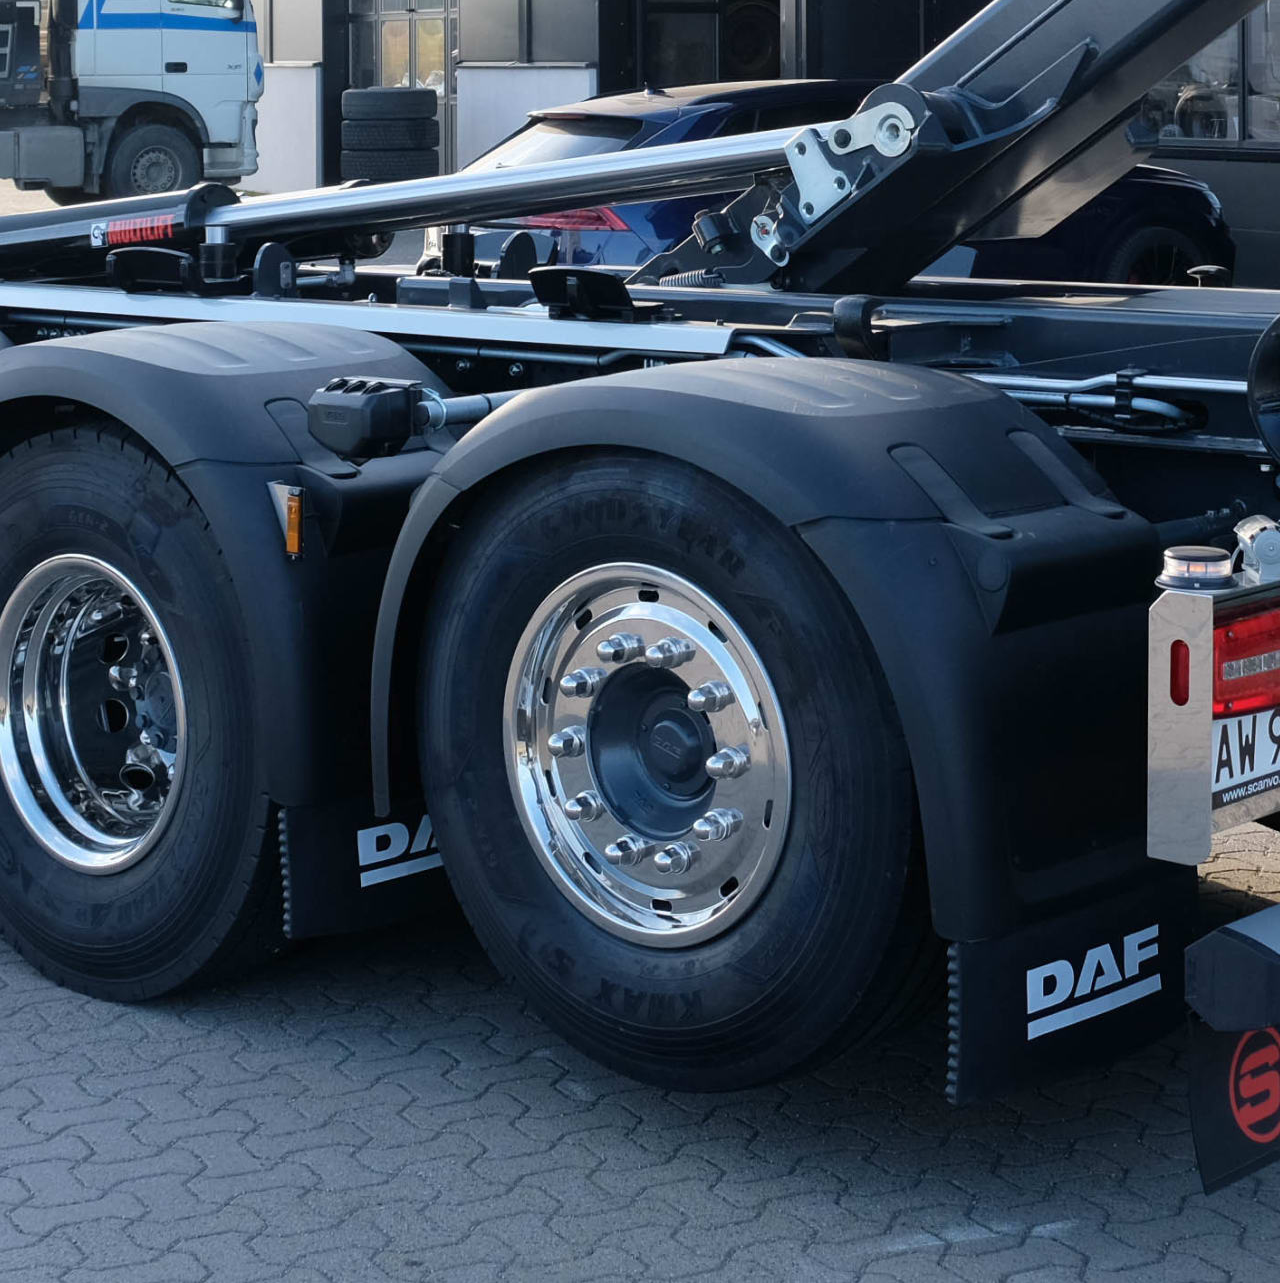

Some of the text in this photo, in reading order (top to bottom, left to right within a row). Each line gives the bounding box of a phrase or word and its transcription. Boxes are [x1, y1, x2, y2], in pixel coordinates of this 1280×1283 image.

[108, 214, 175, 244] MULTILIFT
[1215, 714, 1257, 784] AW
[1026, 923, 1160, 1015] DAF
